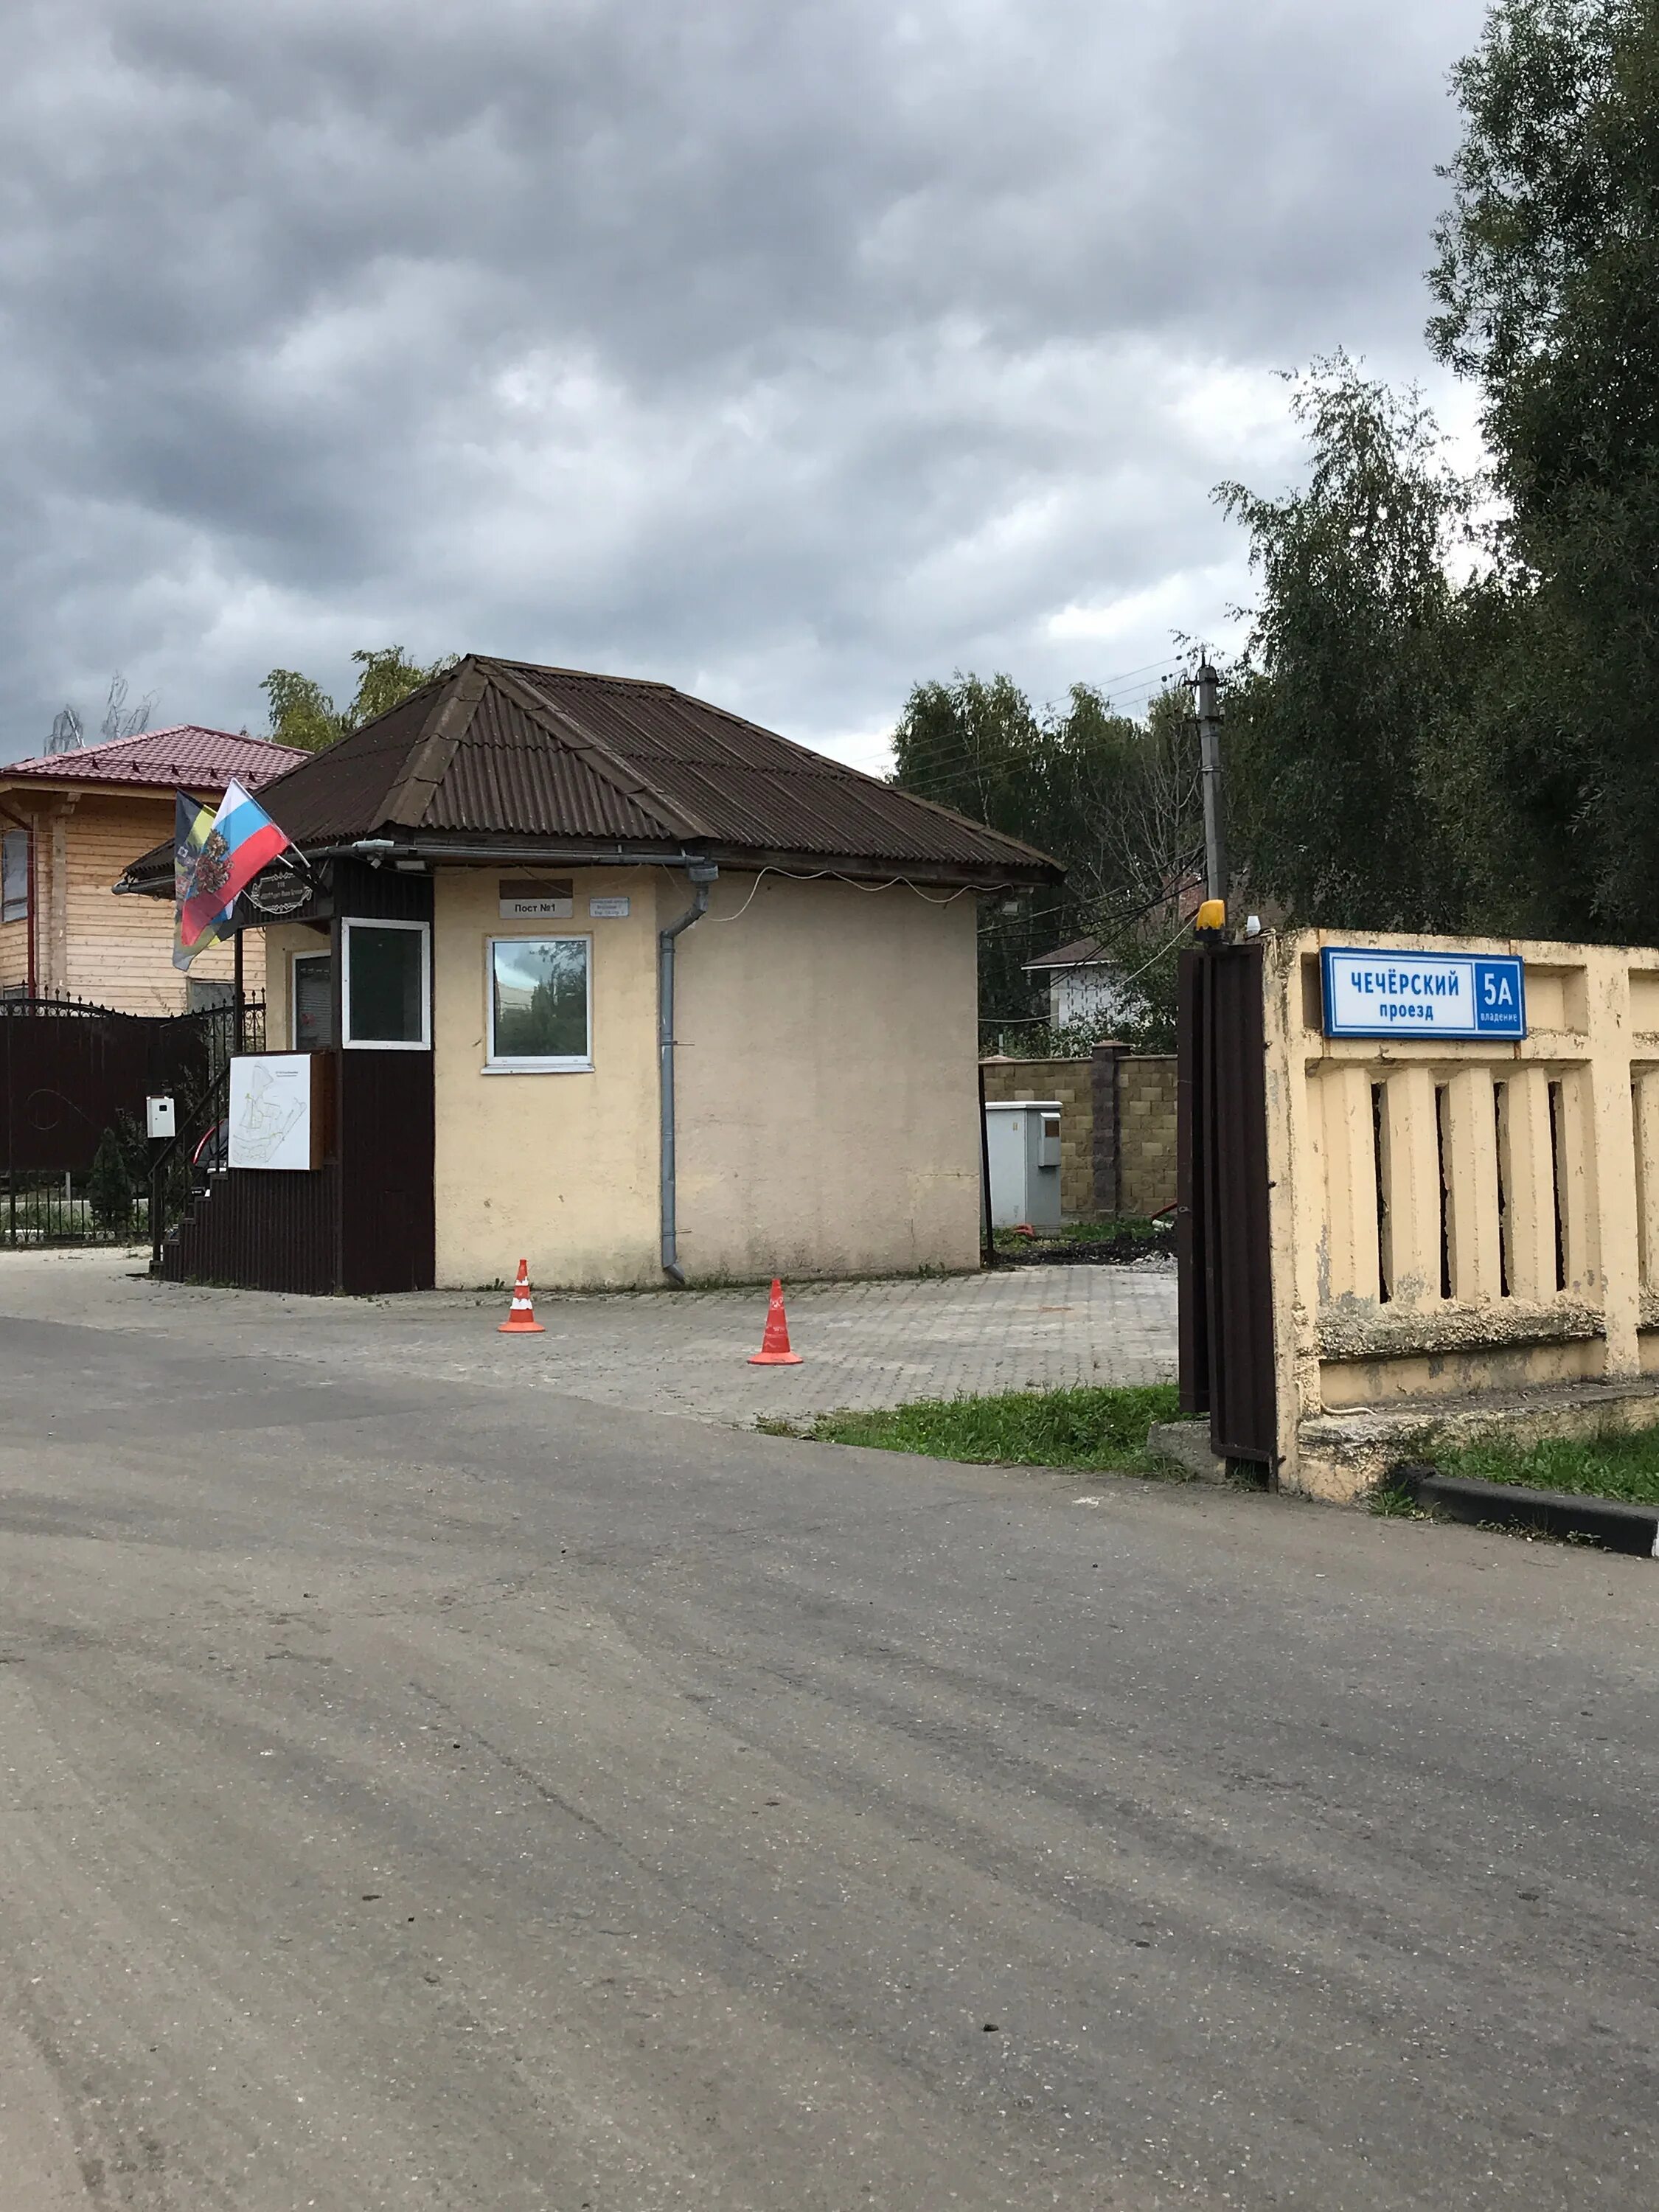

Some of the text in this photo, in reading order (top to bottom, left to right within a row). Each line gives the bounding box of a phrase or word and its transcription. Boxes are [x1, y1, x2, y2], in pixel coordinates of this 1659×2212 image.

[515, 903, 556, 913] Пост №1
[1351, 968, 1459, 996] ЧЕЧЁРСКИЙ
[1484, 973, 1513, 1006] 5А
[1380, 1004, 1434, 1021] проезд
[1480, 1012, 1518, 1023] владение
